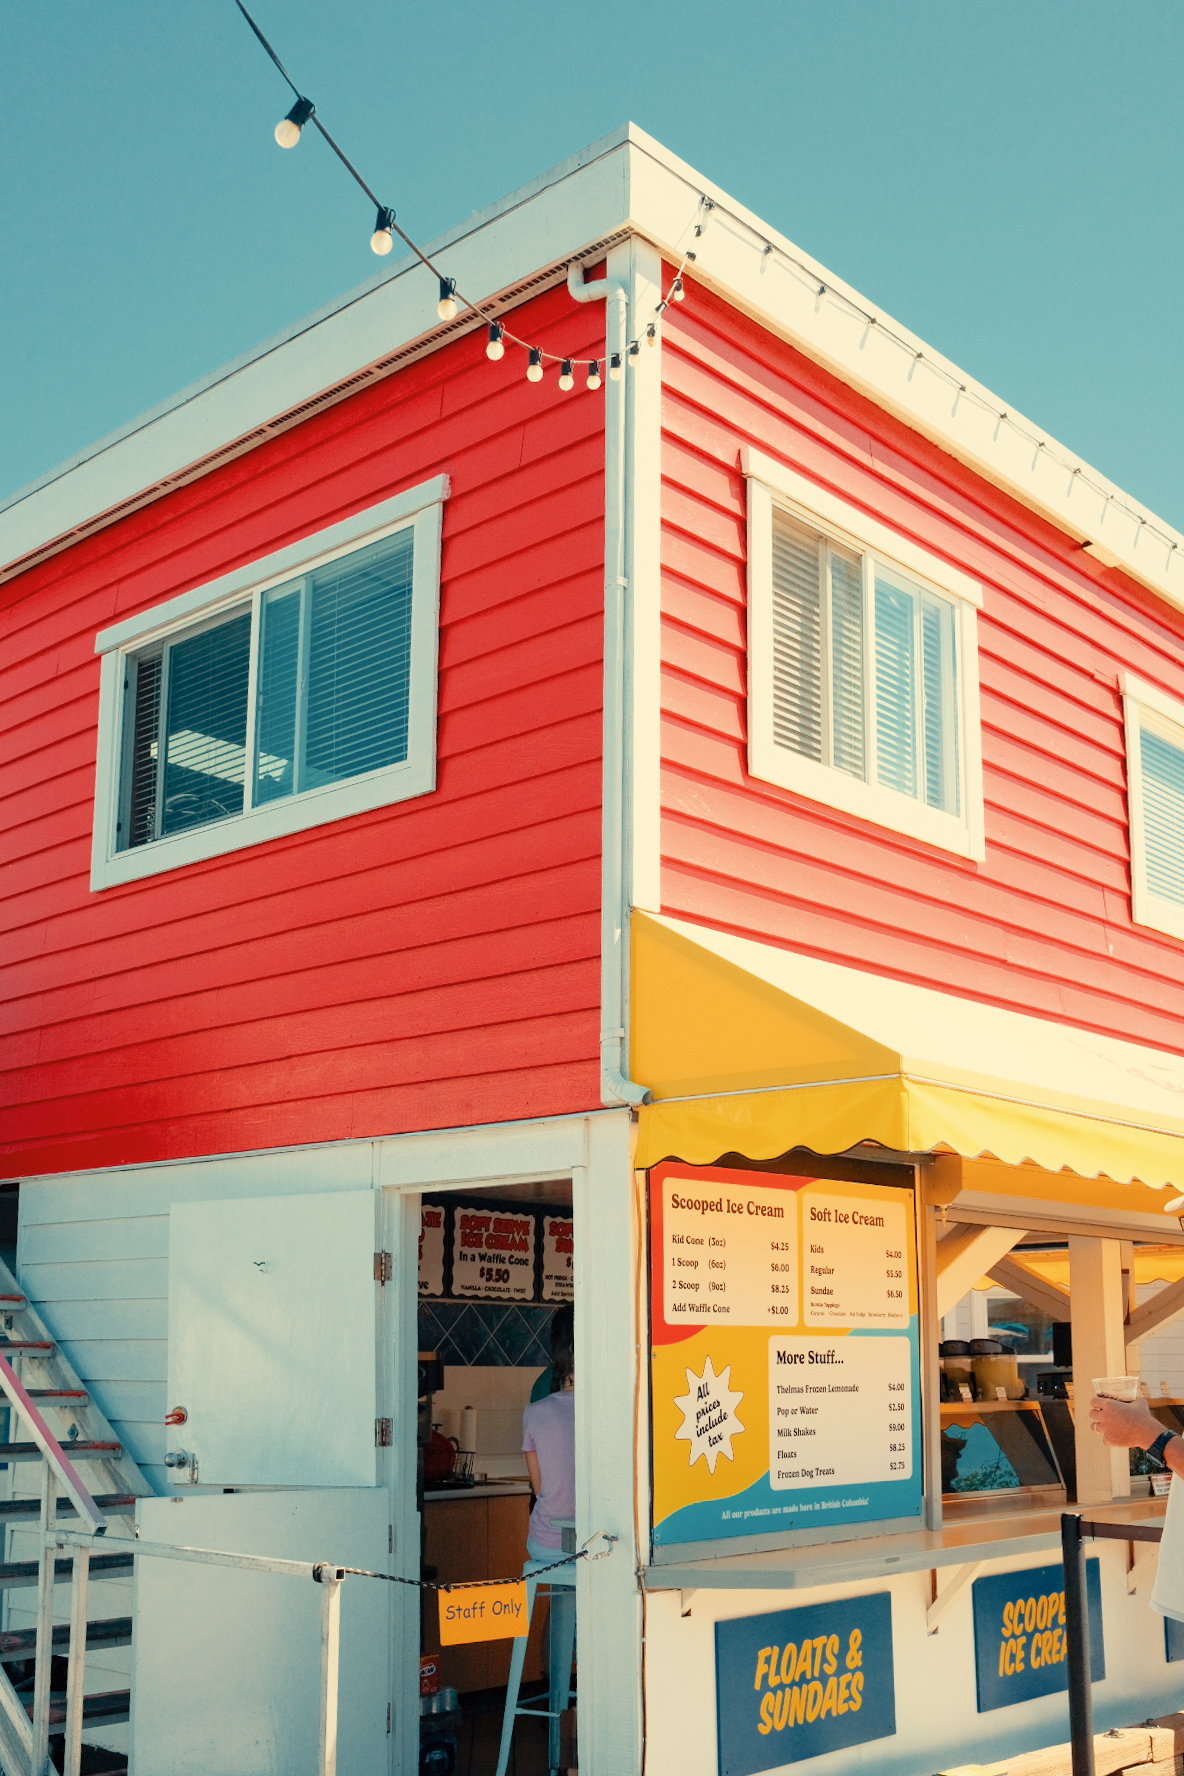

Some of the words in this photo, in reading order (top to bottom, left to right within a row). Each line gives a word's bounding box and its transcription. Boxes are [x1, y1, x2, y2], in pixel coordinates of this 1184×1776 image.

[671, 1193, 723, 1215] Scooped
[726, 1199, 744, 1214] Ice
[746, 1200, 785, 1218] Cream
[459, 1214, 492, 1232] SOFT
[492, 1217, 531, 1236] SERVE
[810, 1206, 832, 1222] Soft
[834, 1209, 850, 1223] Ice
[851, 1210, 885, 1227] Cream
[549, 1220, 573, 1237] SOF
[460, 1231, 484, 1248] ICE
[484, 1232, 530, 1254] CREAM
[671, 1234, 685, 1244] Kid
[685, 1235, 705, 1246] Cone
[708, 1236, 726, 1248] (3oz)
[770, 1241, 789, 1251] $4.25
[459, 1250, 469, 1262] In
[470, 1253, 476, 1262] a
[478, 1252, 507, 1265] Waffle
[508, 1254, 530, 1267] Cone
[810, 1244, 824, 1254] Kids
[885, 1249, 902, 1259] $4.00
[671, 1257, 676, 1267] 1
[676, 1258, 699, 1270] Scoop
[708, 1259, 727, 1271] (6oz)
[770, 1262, 790, 1273] $6.00
[810, 1265, 835, 1277] Regular
[886, 1269, 902, 1279] $5.50
[479, 1265, 510, 1284] $5.50
[460, 1284, 482, 1292] VANILLA
[484, 1285, 511, 1294] CHOCOLATE
[672, 1280, 677, 1289] 2
[678, 1280, 700, 1293] Scoop
[708, 1281, 727, 1293] (9oz)
[770, 1284, 790, 1294] $8.25
[810, 1285, 834, 1296] Sundae
[886, 1289, 903, 1299] $6.50
[671, 1302, 686, 1313] Add
[688, 1303, 711, 1313] Waffle
[712, 1303, 730, 1314] Cone
[767, 1305, 789, 1315] +$1.00
[776, 1350, 805, 1365] More
[807, 1349, 844, 1365] Stuff...
[696, 1381, 710, 1402] All
[776, 1385, 804, 1394] Thelmas
[805, 1384, 827, 1394] Frozen
[827, 1383, 860, 1393] Lemonade
[888, 1382, 905, 1392] $4.00
[696, 1399, 721, 1424] prices
[776, 1407, 790, 1418] Pop
[790, 1406, 799, 1415] or
[799, 1406, 819, 1415] Water
[888, 1402, 905, 1412] $2.50
[695, 1408, 729, 1438] include
[777, 1428, 792, 1437] Milk
[793, 1427, 816, 1437] Shakes
[888, 1423, 905, 1432] $9.00
[708, 1431, 724, 1448] tax
[777, 1450, 797, 1459] Floats
[889, 1443, 906, 1452] $8.25
[777, 1469, 800, 1479] Frozen
[801, 1468, 814, 1479] Dog
[815, 1467, 835, 1476] Treats
[889, 1461, 905, 1471] $2.75
[721, 1510, 731, 1520] All
[731, 1511, 743, 1519] our
[743, 1507, 771, 1520] products
[771, 1507, 782, 1515] are
[782, 1504, 799, 1514] made
[799, 1503, 813, 1512] here
[813, 1501, 820, 1510] in
[820, 1500, 841, 1510] British
[445, 1601, 485, 1621] Staff
[492, 1598, 522, 1619] Only
[1001, 1591, 1067, 1638] SCOOPE
[754, 1633, 840, 1691] FLOATS
[845, 1628, 863, 1670] &
[998, 1636, 1027, 1678] ICE
[1030, 1627, 1068, 1670] CREA
[757, 1671, 865, 1736] SUNDAES
